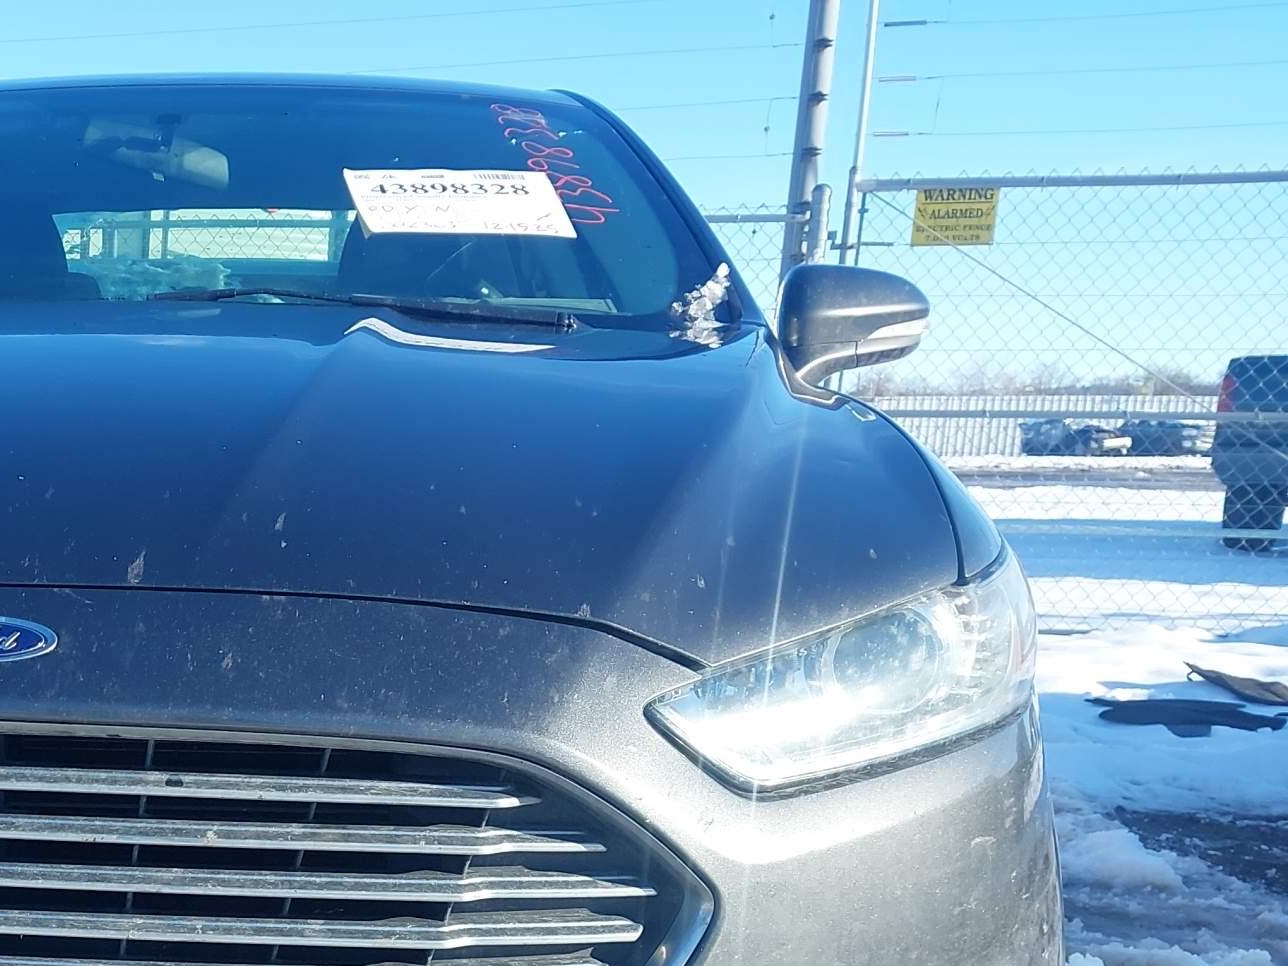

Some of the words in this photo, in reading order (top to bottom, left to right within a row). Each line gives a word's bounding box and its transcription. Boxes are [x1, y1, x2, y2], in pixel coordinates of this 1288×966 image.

[370, 183, 530, 195] 43898328
[923, 188, 995, 201] WARNING
[929, 208, 984, 219] ALARMED
